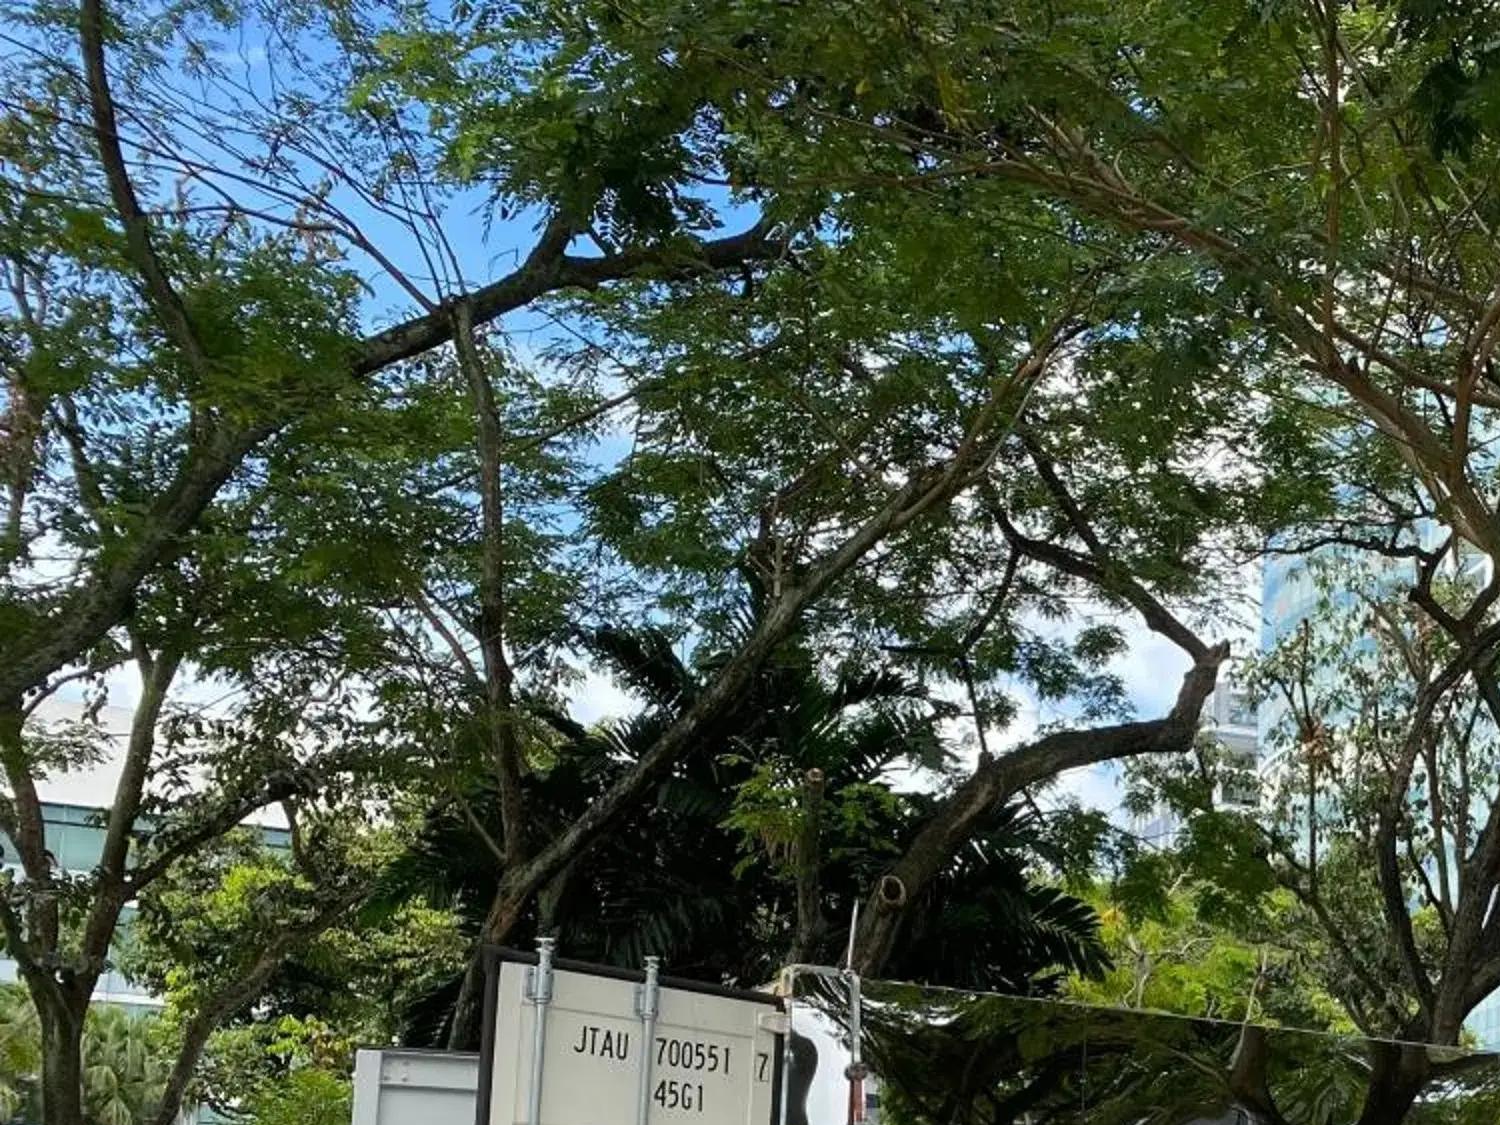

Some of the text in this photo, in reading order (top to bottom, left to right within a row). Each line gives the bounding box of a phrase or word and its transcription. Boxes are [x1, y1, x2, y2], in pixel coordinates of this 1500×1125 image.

[574, 1026, 769, 1081] JTAU 700551 7
[654, 1079, 703, 1112] 45G1
